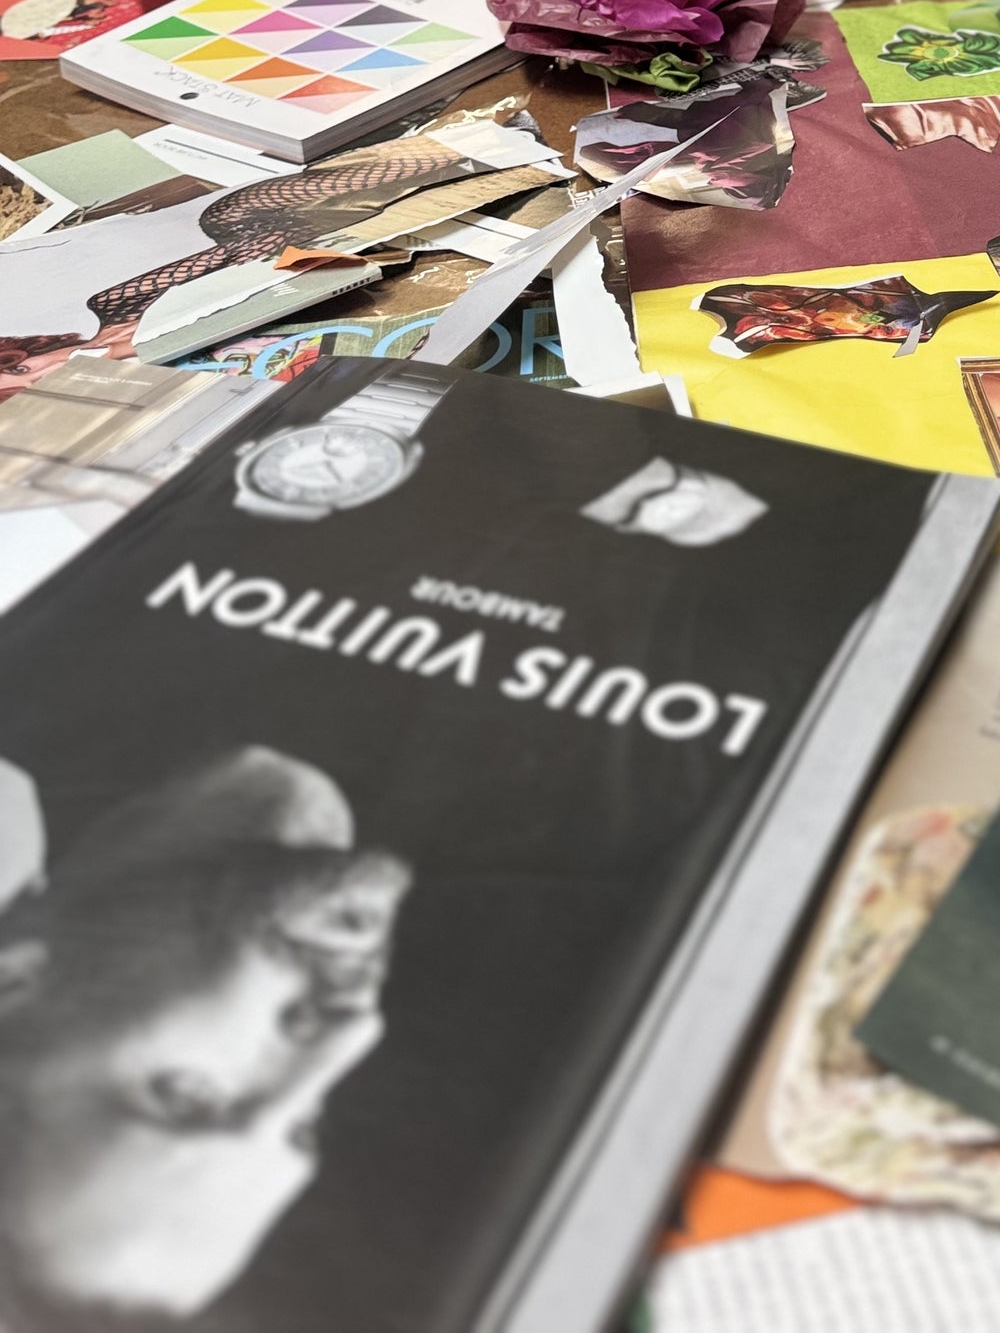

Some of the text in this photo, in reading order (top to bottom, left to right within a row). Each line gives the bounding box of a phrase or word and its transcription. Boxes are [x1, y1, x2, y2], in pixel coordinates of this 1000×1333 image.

[145, 562, 767, 757] LOUIS VUITTON
[410, 574, 565, 632] TAMBOUR
